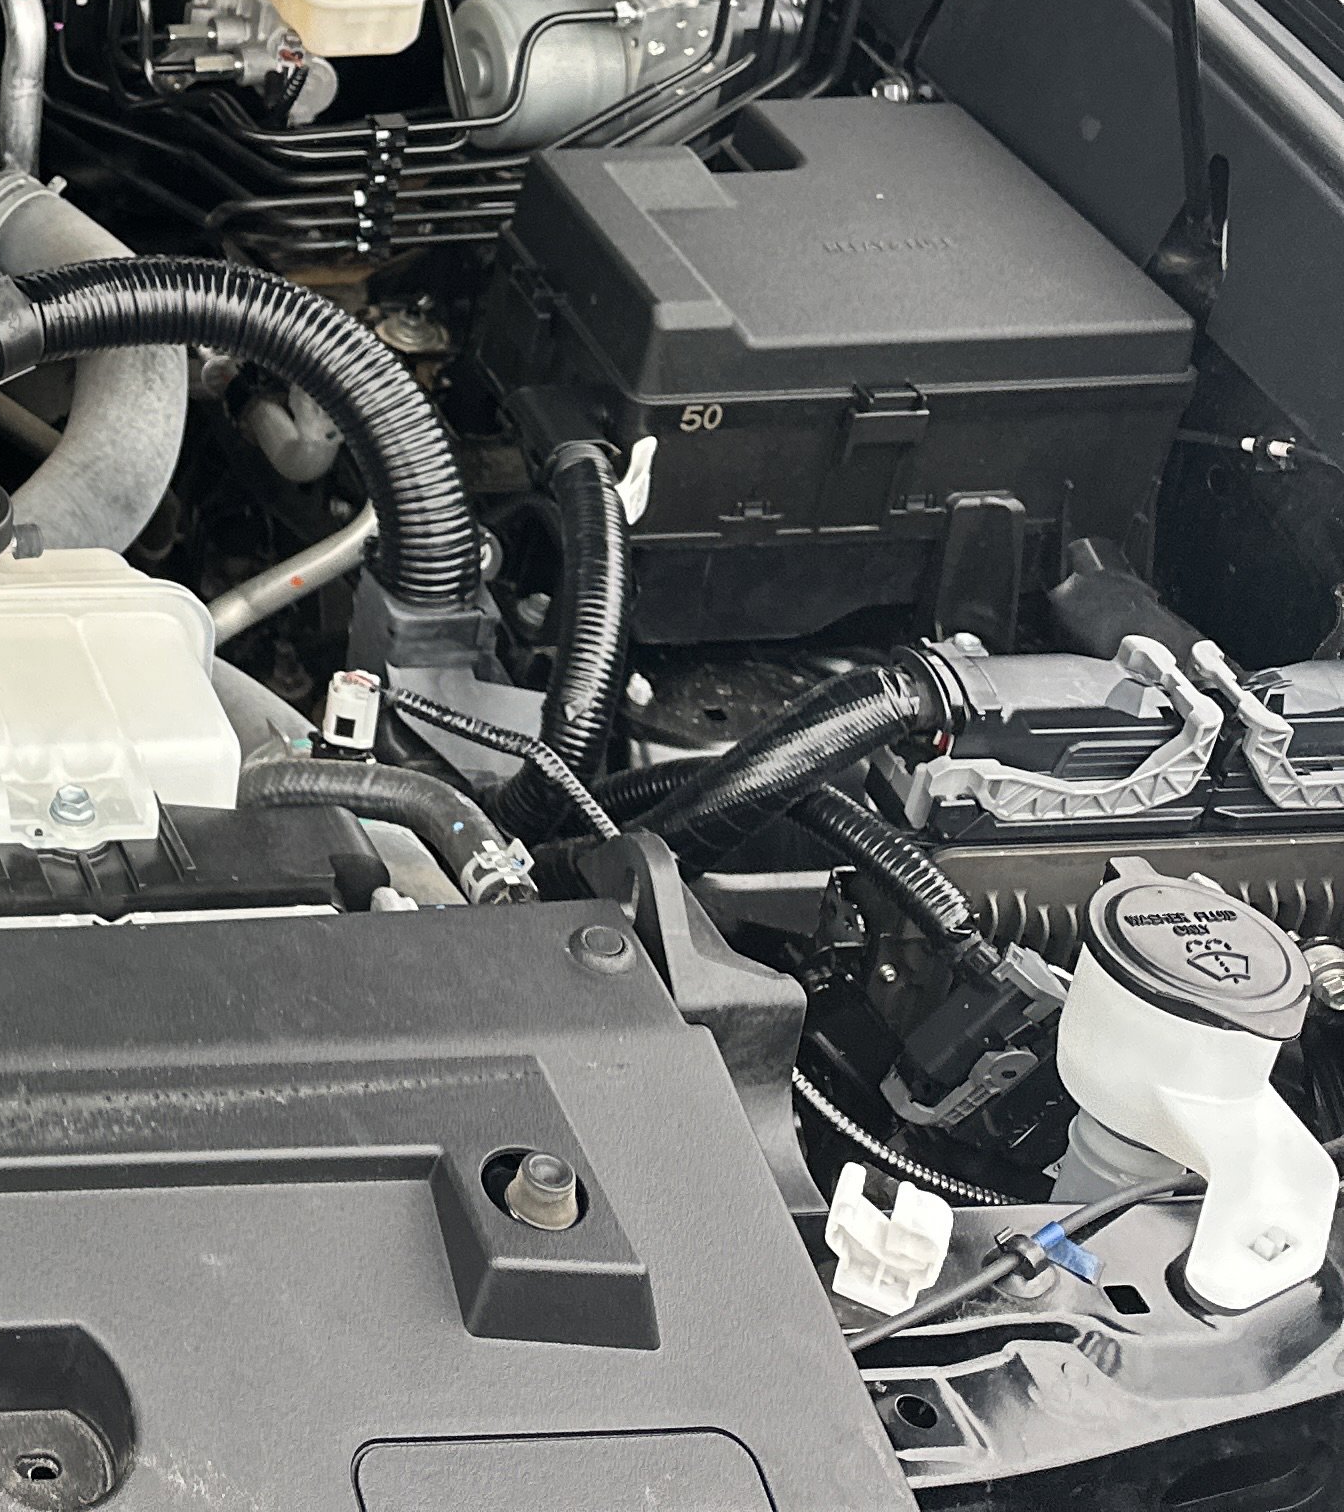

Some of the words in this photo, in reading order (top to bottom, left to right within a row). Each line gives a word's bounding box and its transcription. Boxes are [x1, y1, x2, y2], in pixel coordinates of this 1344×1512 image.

[680, 404, 723, 432] 50
[1124, 912, 1191, 927] WASHER
[1193, 910, 1238, 922] FLUID
[1172, 924, 1210, 936] ONLY
